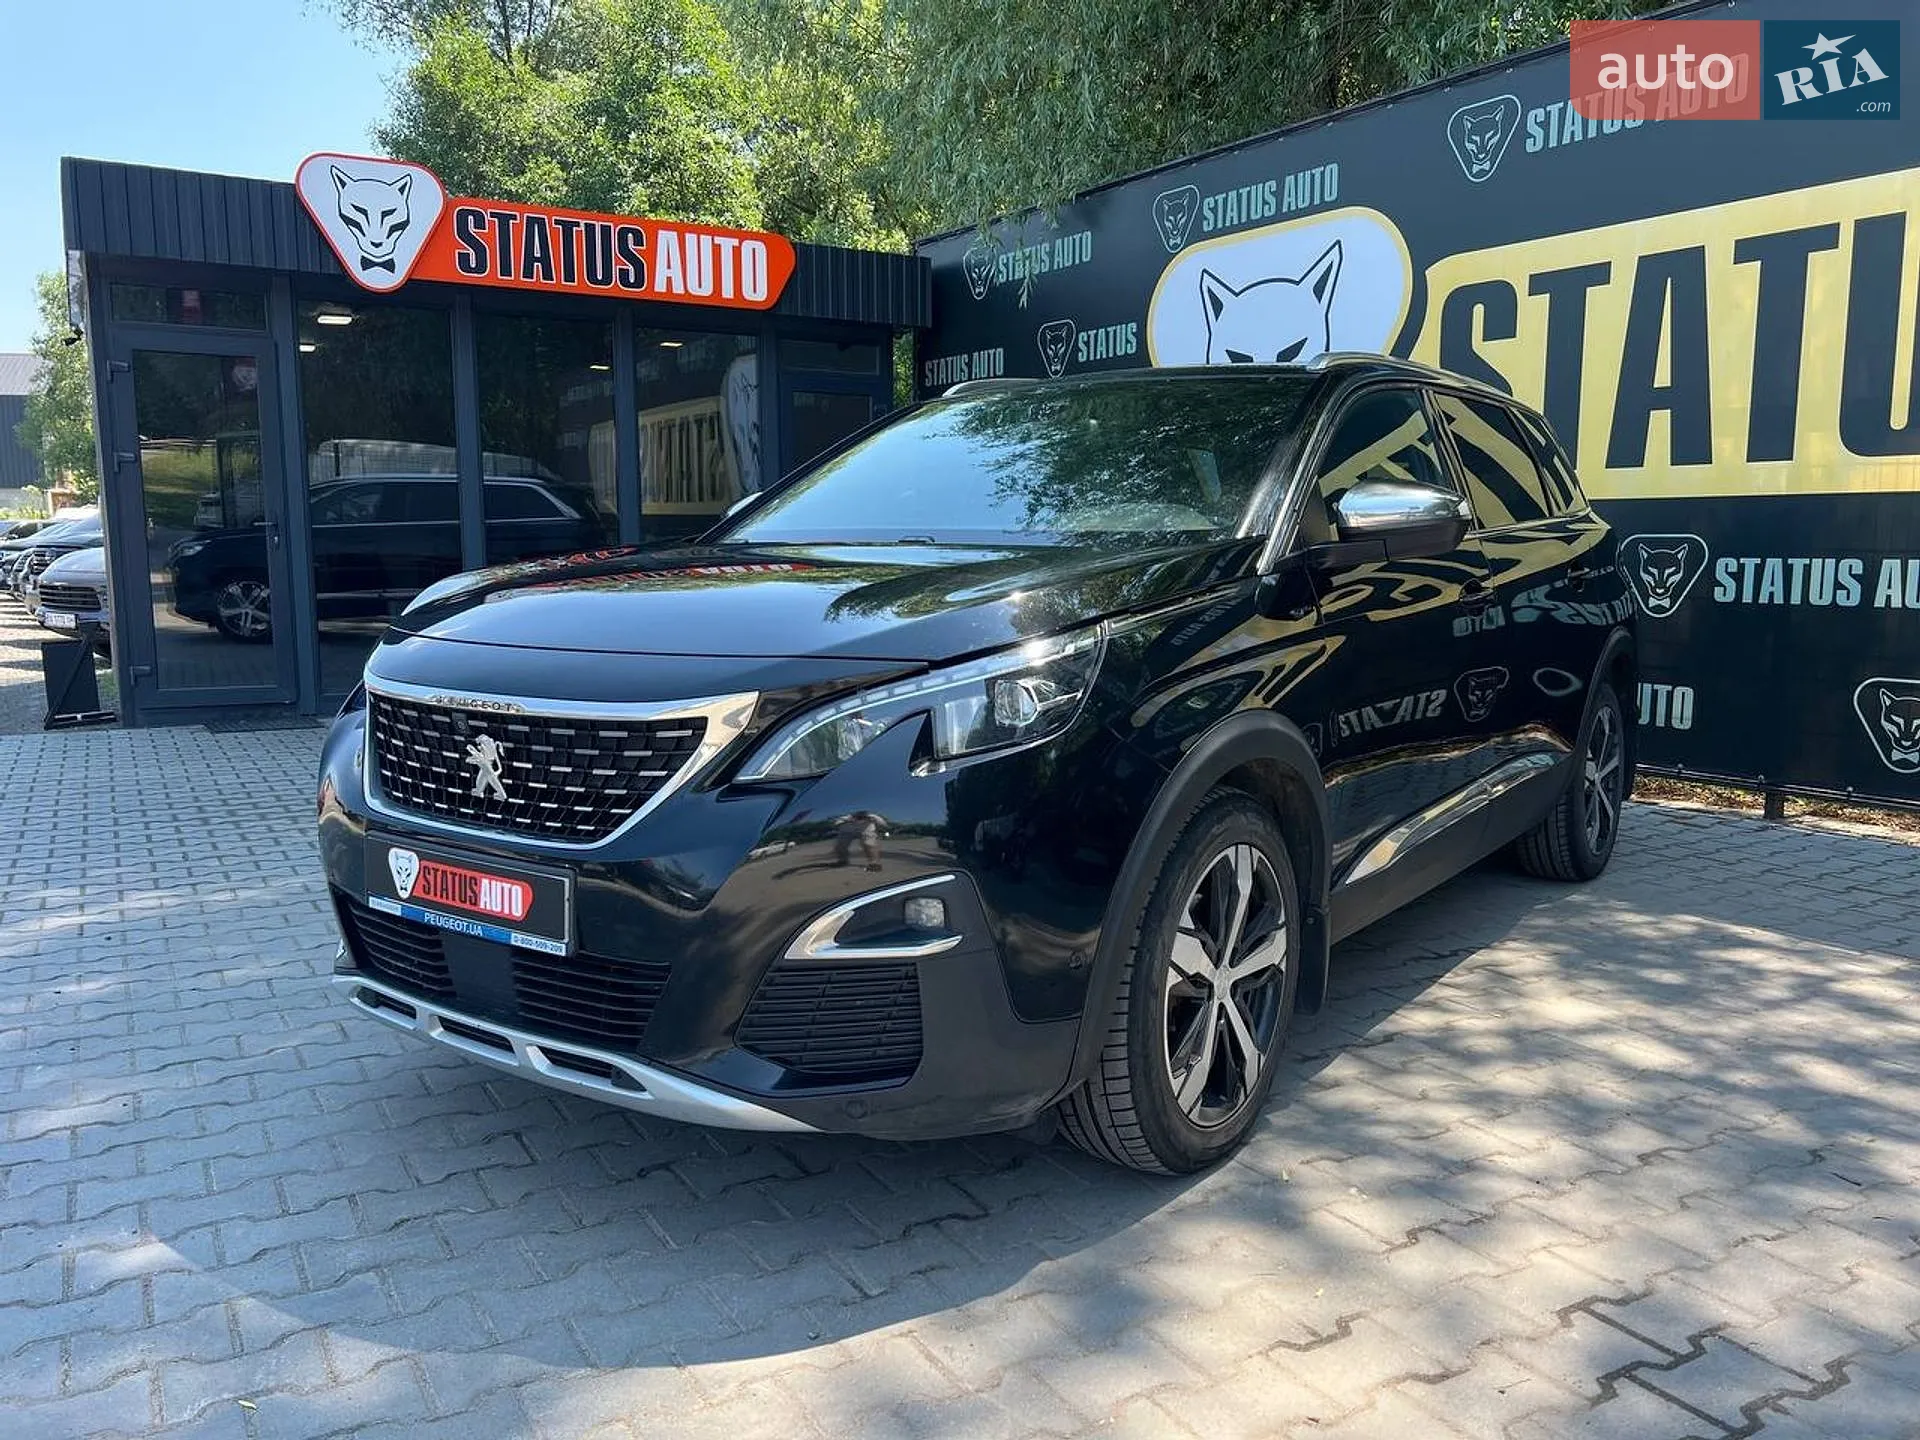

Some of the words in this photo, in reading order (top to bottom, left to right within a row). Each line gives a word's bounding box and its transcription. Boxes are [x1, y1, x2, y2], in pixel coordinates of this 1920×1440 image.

[1525, 81, 1646, 153] STATUS
[1203, 180, 1277, 232] STATUS
[1282, 163, 1339, 212] AUTO
[452, 206, 646, 291] STATUS
[654, 229, 768, 301] AUTO
[998, 243, 1050, 284] STATUS
[1053, 231, 1092, 270] AUTO
[925, 353, 969, 388] STATUS
[972, 348, 1004, 379] AUTO
[1078, 322, 1137, 363] STATUS
[1713, 557, 1863, 607] STATUS
[423, 866, 478, 907] STATUS
[479, 878, 524, 917] AUTO
[424, 911, 483, 936] PEUGEOT.UA
